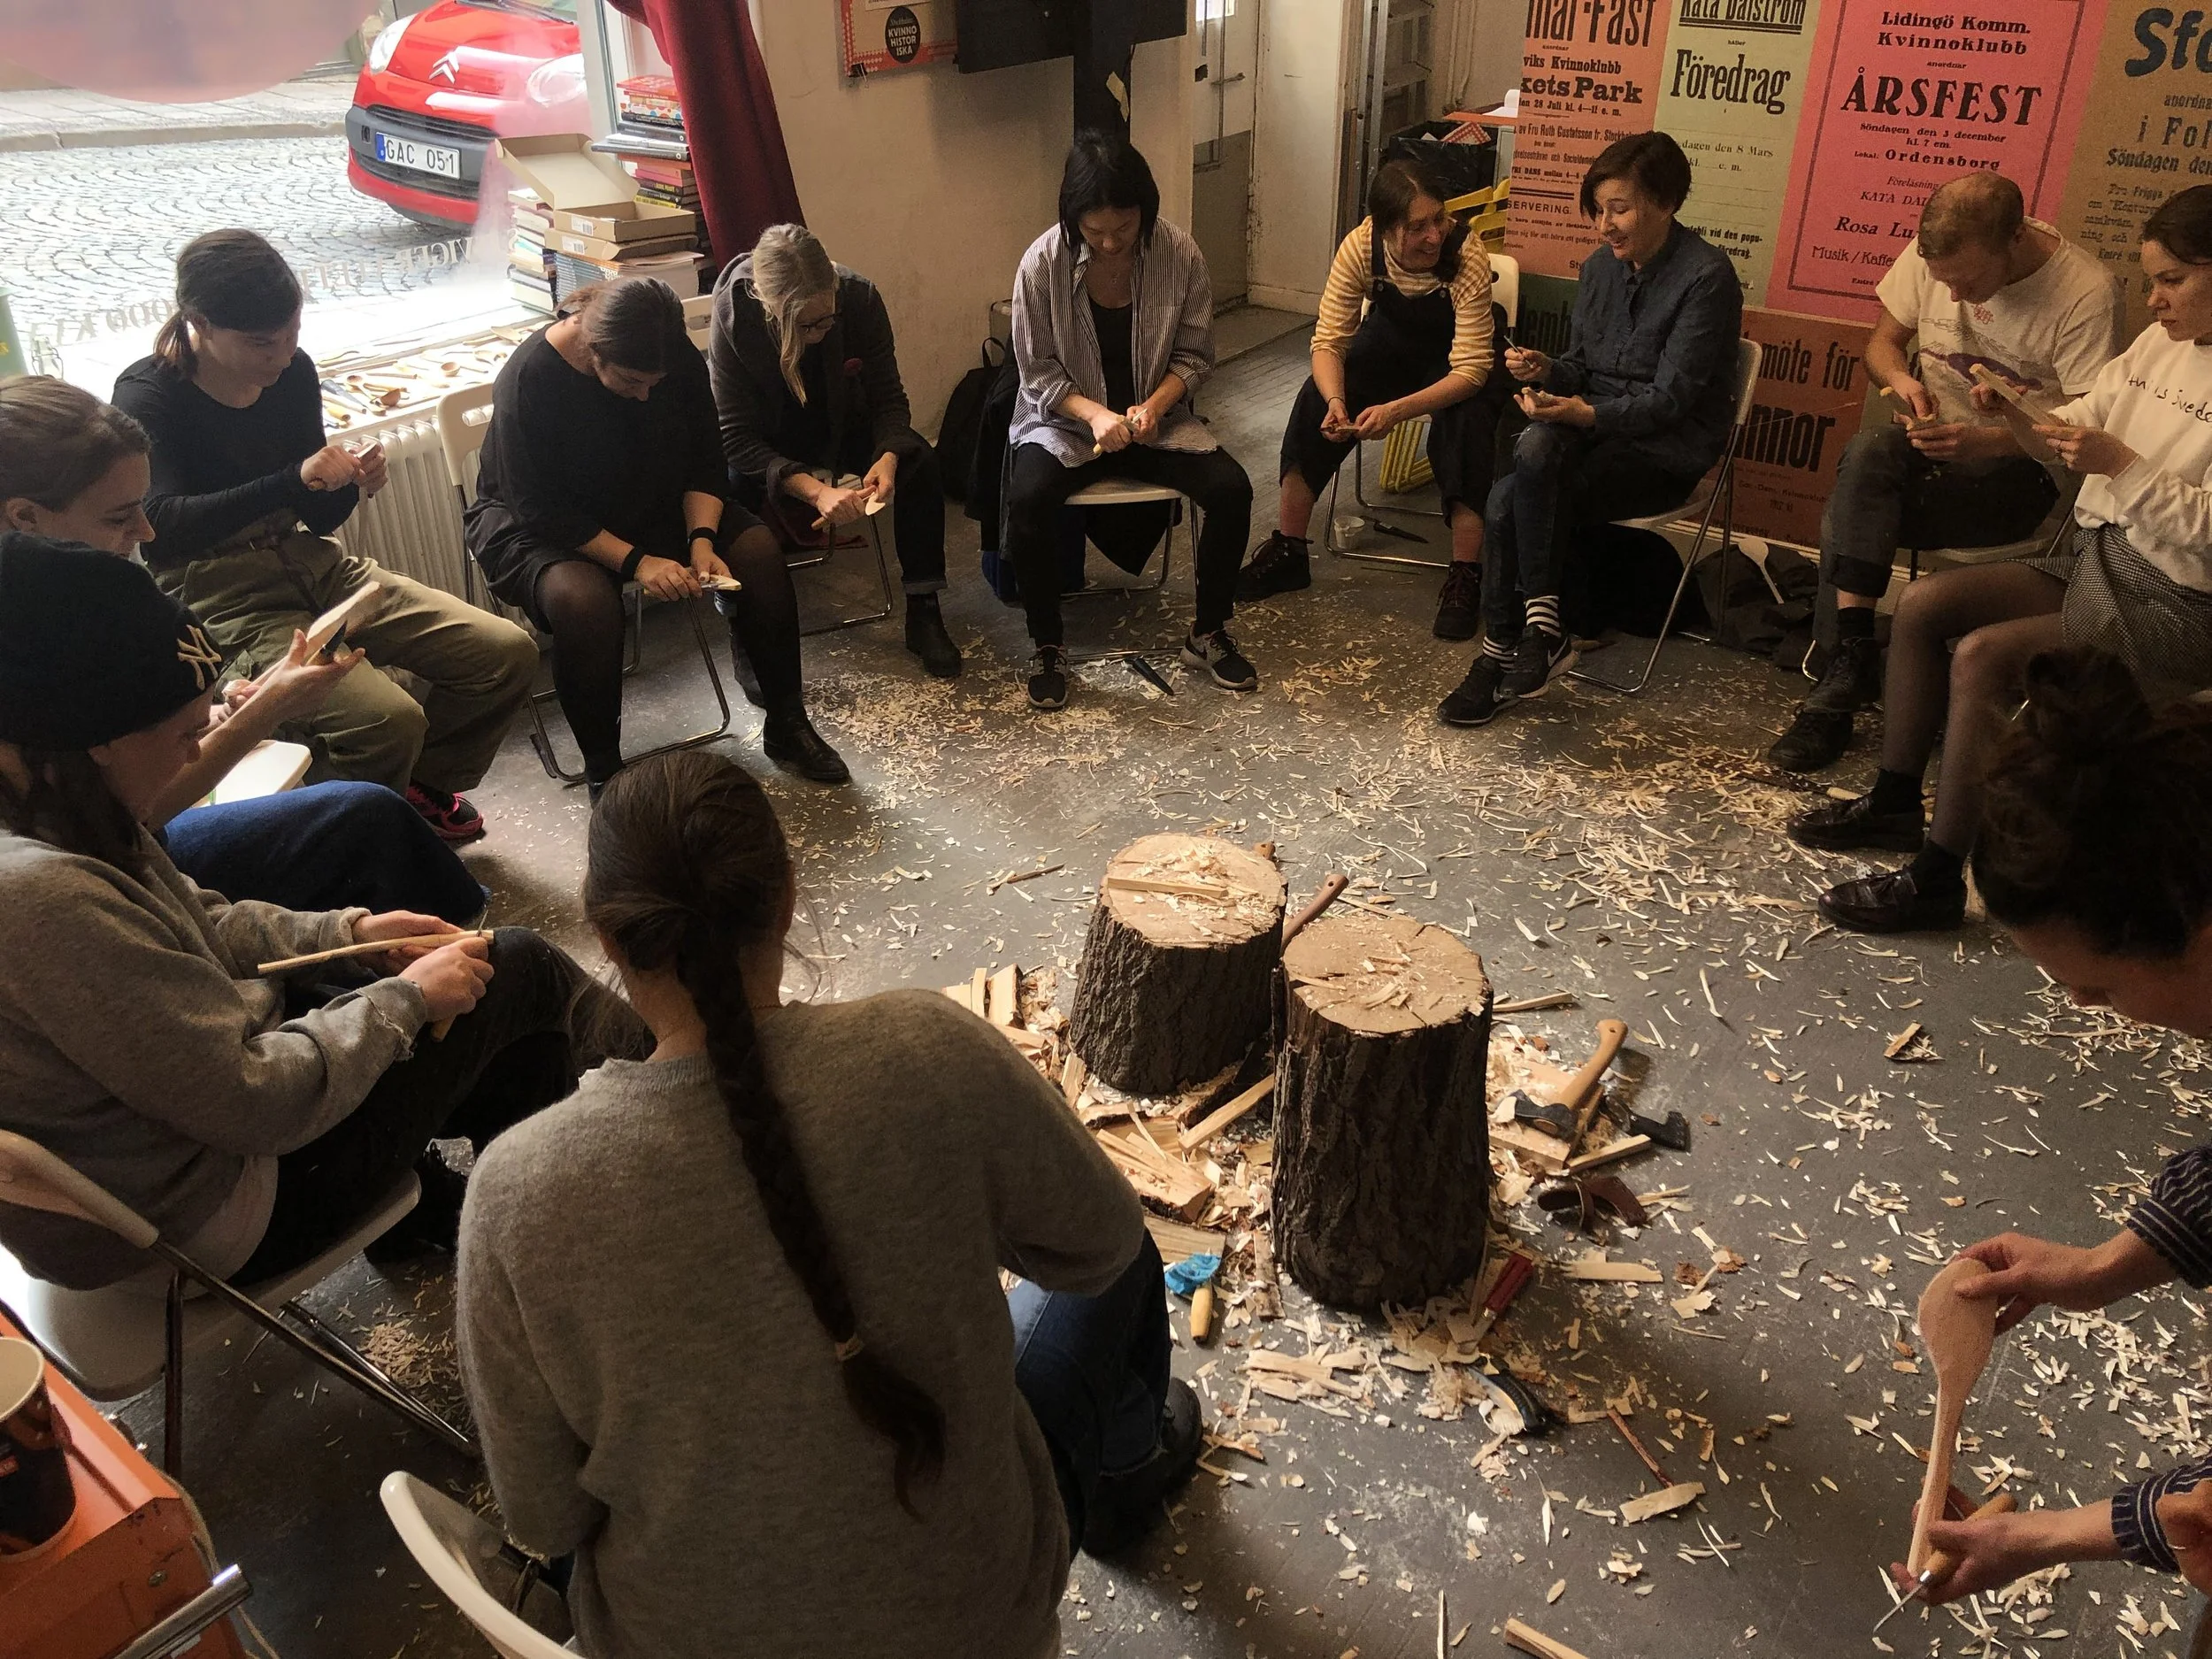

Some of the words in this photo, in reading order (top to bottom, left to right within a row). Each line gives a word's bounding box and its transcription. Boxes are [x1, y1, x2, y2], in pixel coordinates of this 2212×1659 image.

[888, 26, 918, 38] KVINNO
[1881, 11, 1955, 30] Lidingö
[1961, 16, 2032, 35] Komm.
[891, 36, 917, 47] HISTOR
[896, 46, 913, 56] ISKA
[1877, 32, 2027, 55] Kvinnoklubb
[1551, 56, 1622, 74] Kvinnoklubb
[1573, 76, 1643, 104] Park
[1671, 49, 1792, 115] Föredrag
[1547, 100, 1562, 111] Juli
[1840, 66, 2042, 126] ÅRSFEST
[1860, 123, 1909, 134] Söndagen
[1916, 127, 1937, 137] den
[1954, 131, 2006, 143] december
[2138, 115, 2149, 142] i
[387, 139, 415, 164] GAC
[426, 149, 454, 174] 051
[1715, 142, 1732, 152] den
[1748, 145, 1774, 157] Mars
[1885, 149, 2001, 172] Ordensborg
[2106, 147, 2179, 173] Söndagen
[1860, 191, 1895, 204] KATA
[1834, 216, 1878, 234] Rosa
[1709, 227, 1722, 238] vid
[1724, 230, 1738, 241] den
[1740, 233, 1763, 245] popu-
[1812, 245, 1849, 262] Musik
[1823, 341, 1860, 392] för
